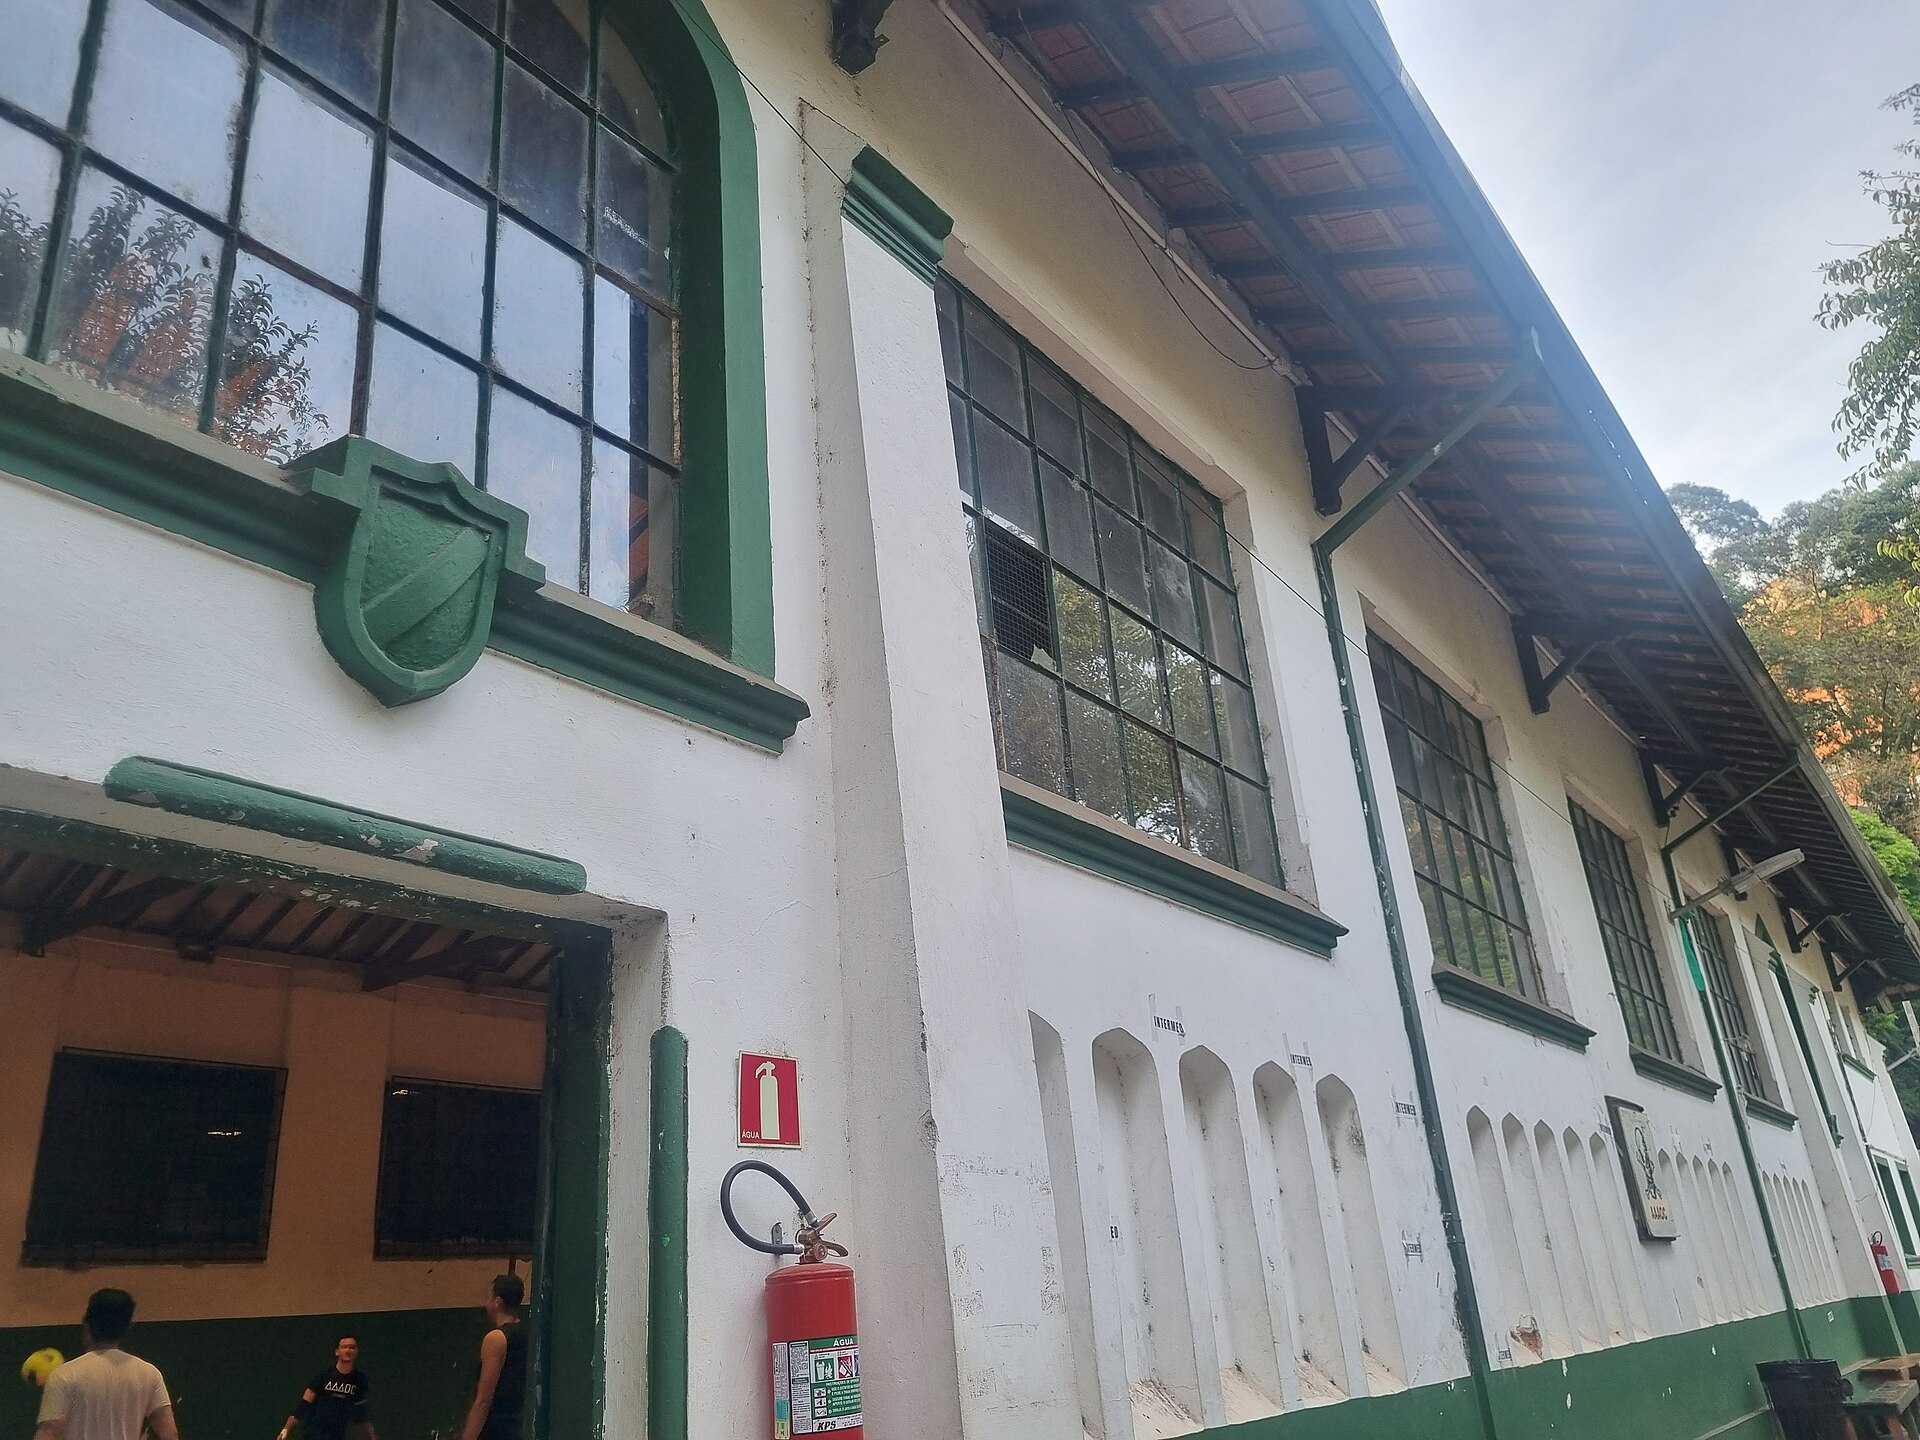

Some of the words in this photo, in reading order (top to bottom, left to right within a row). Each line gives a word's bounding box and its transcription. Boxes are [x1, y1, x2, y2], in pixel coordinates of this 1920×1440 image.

[741, 1129, 760, 1139] ÁGUA
[833, 1338, 854, 1347] ÁGUA
[817, 1420, 837, 1431] KPS
